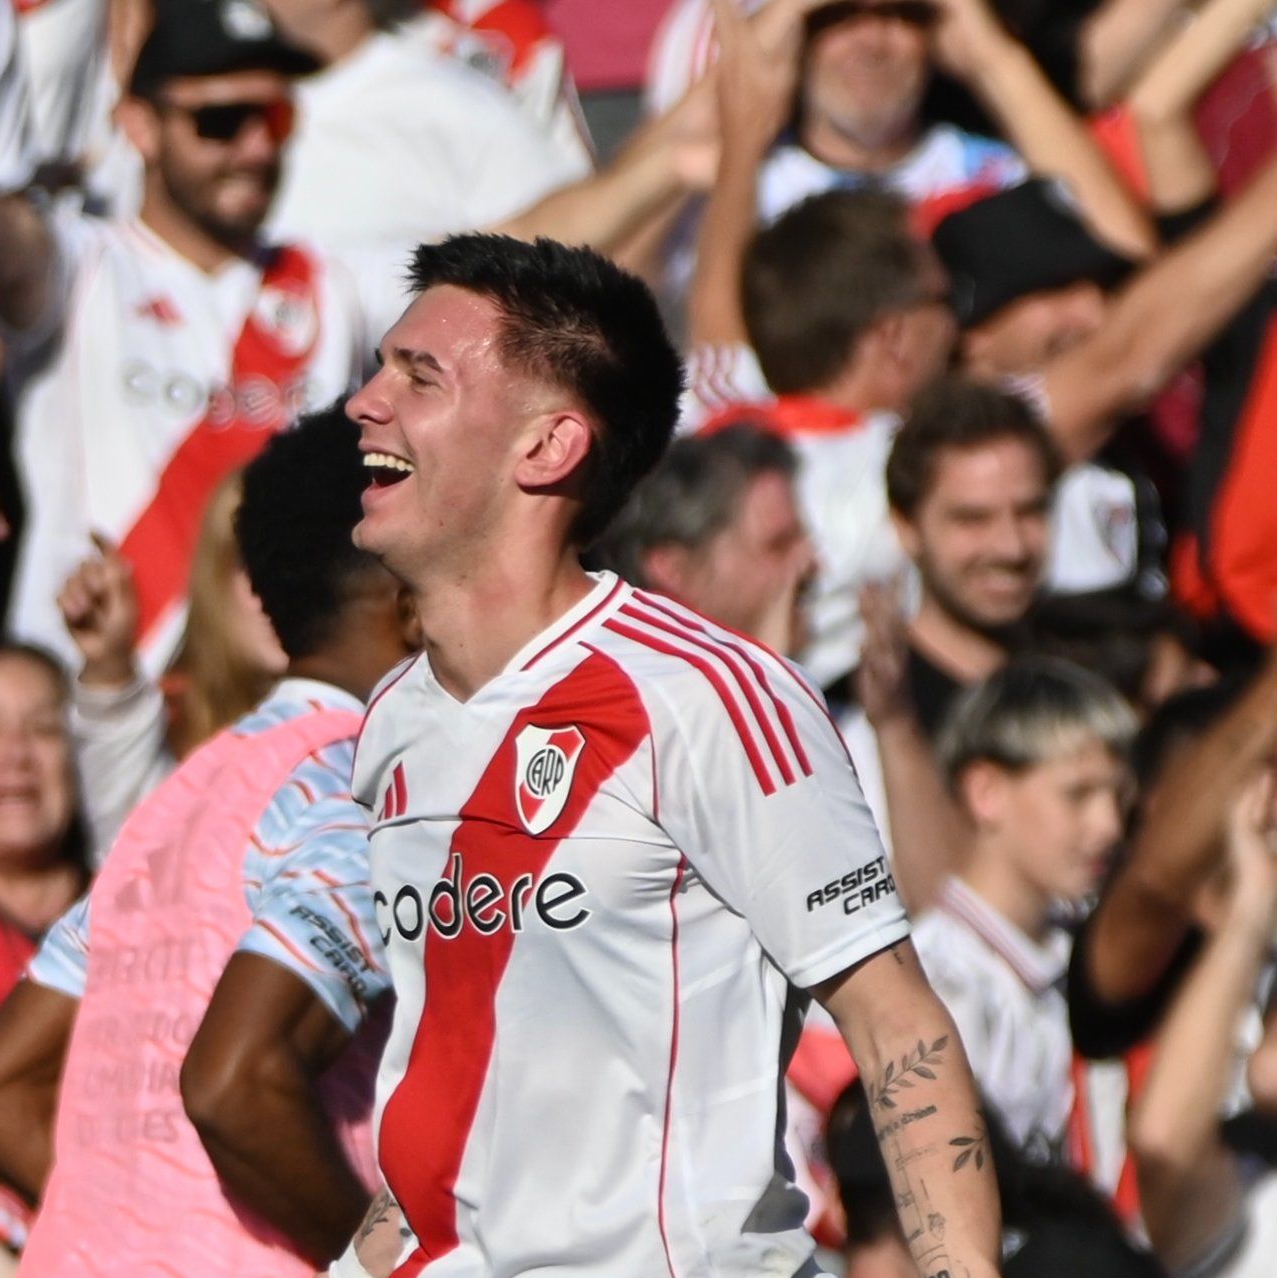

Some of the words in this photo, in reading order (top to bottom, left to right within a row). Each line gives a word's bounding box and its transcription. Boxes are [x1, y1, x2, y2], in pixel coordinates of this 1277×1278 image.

[373, 851, 592, 947] codere
[806, 855, 886, 913] ASSIST
[843, 872, 897, 916] CARD
